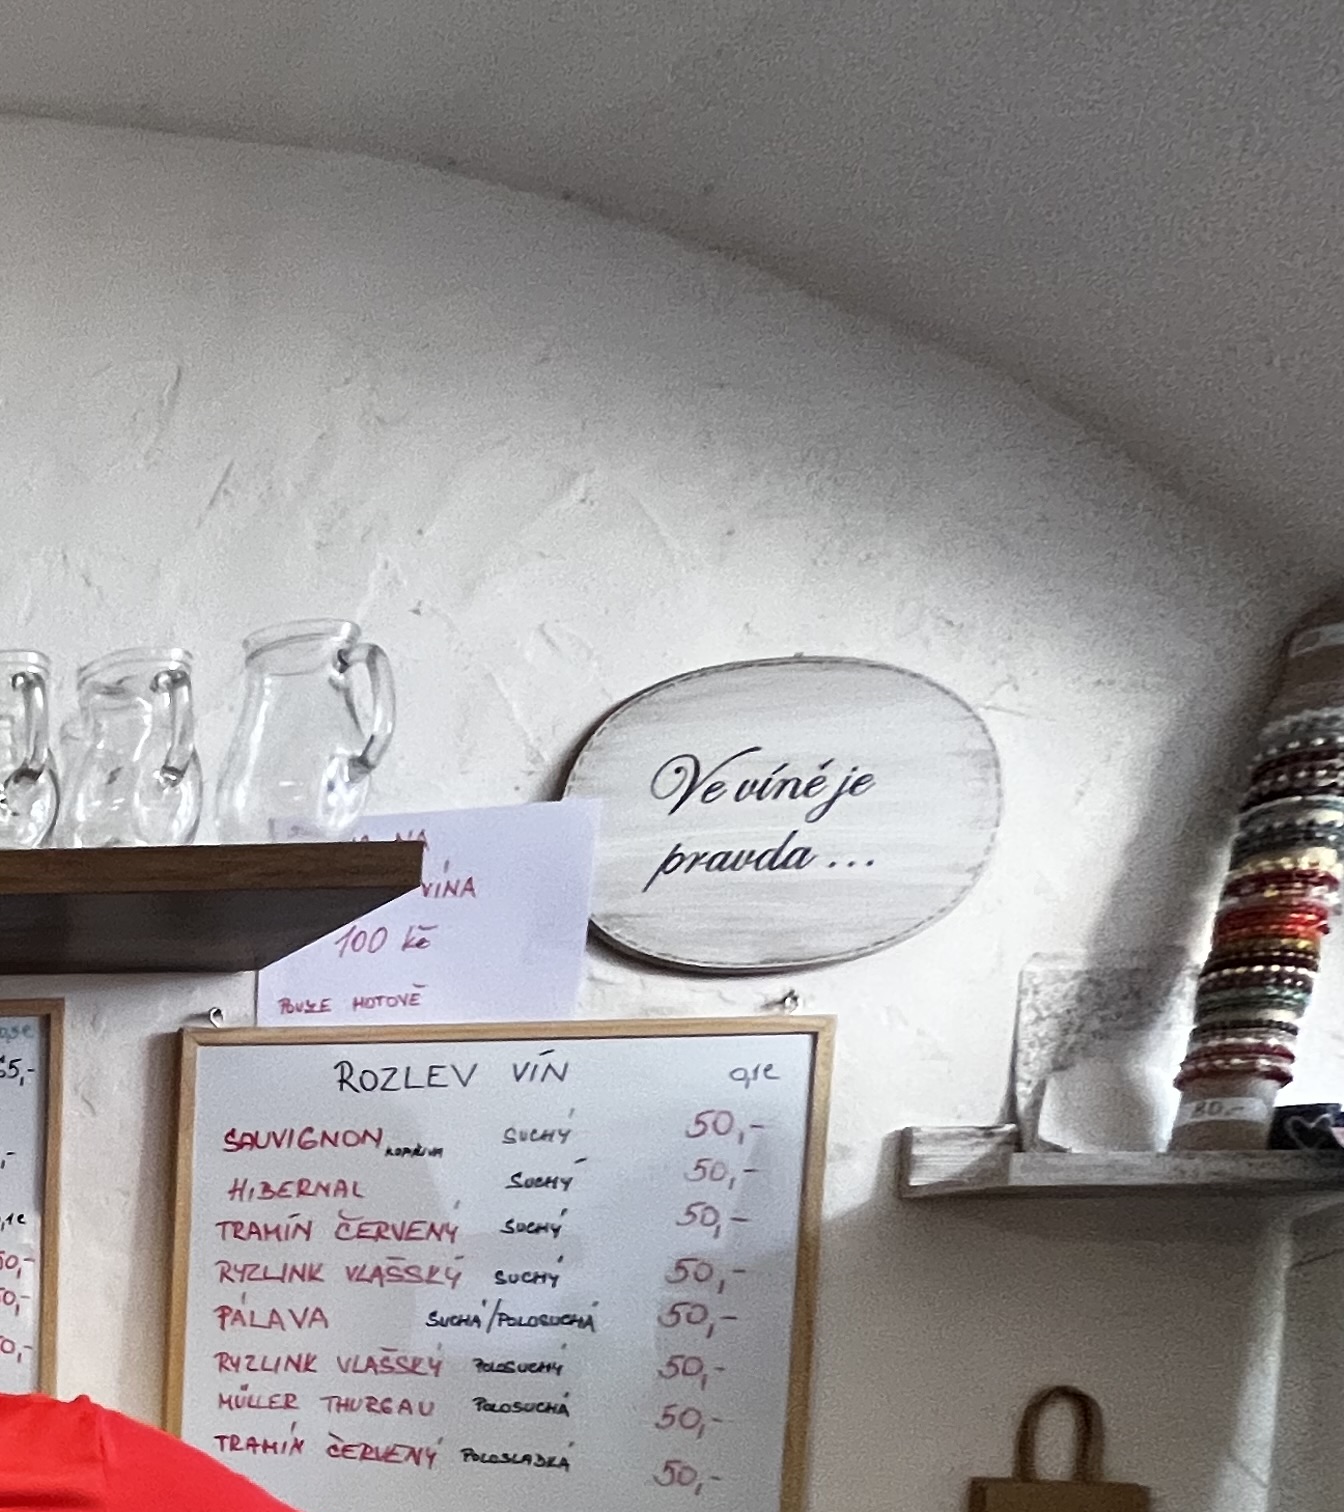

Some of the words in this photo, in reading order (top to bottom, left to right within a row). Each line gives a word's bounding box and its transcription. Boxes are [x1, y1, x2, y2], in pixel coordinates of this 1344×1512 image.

[650, 746, 762, 816] Ve
[805, 766, 876, 823] je
[334, 924, 388, 958] 100
[334, 1060, 478, 1093] ROZLEV
[512, 1049, 569, 1083] VÍN
[223, 1126, 383, 1152] SAUVIGNON
[501, 1107, 572, 1145] SUCHÝ
[685, 1110, 765, 1145] 50,-
[227, 1178, 366, 1201] HIBERNAL
[504, 1157, 588, 1192] SUCHÝ
[684, 1158, 759, 1190] 50,-
[215, 1212, 312, 1242] TRAMÍN
[334, 1199, 460, 1243] ČERVENÝ
[499, 1208, 568, 1239] SUCHÝ
[676, 1201, 750, 1240] 50,-
[215, 1260, 324, 1284] RYZLINK
[494, 1255, 564, 1288] SUCHÝ
[665, 1258, 747, 1294] 50,-
[214, 1292, 330, 1331] PÁLAVA
[657, 1301, 738, 1339] 50,-
[214, 1352, 318, 1374] RYZLINK
[472, 1343, 564, 1377] POLOSUCHÝ
[657, 1355, 726, 1391] 50,-
[320, 1396, 436, 1416] THURGAU
[472, 1391, 570, 1418] POLOSUCHÁ
[654, 1404, 724, 1440] 50,-
[214, 1422, 305, 1456] TRAMÍN
[326, 1431, 444, 1470] ČERVENÝ
[652, 1459, 722, 1496] 50,-
